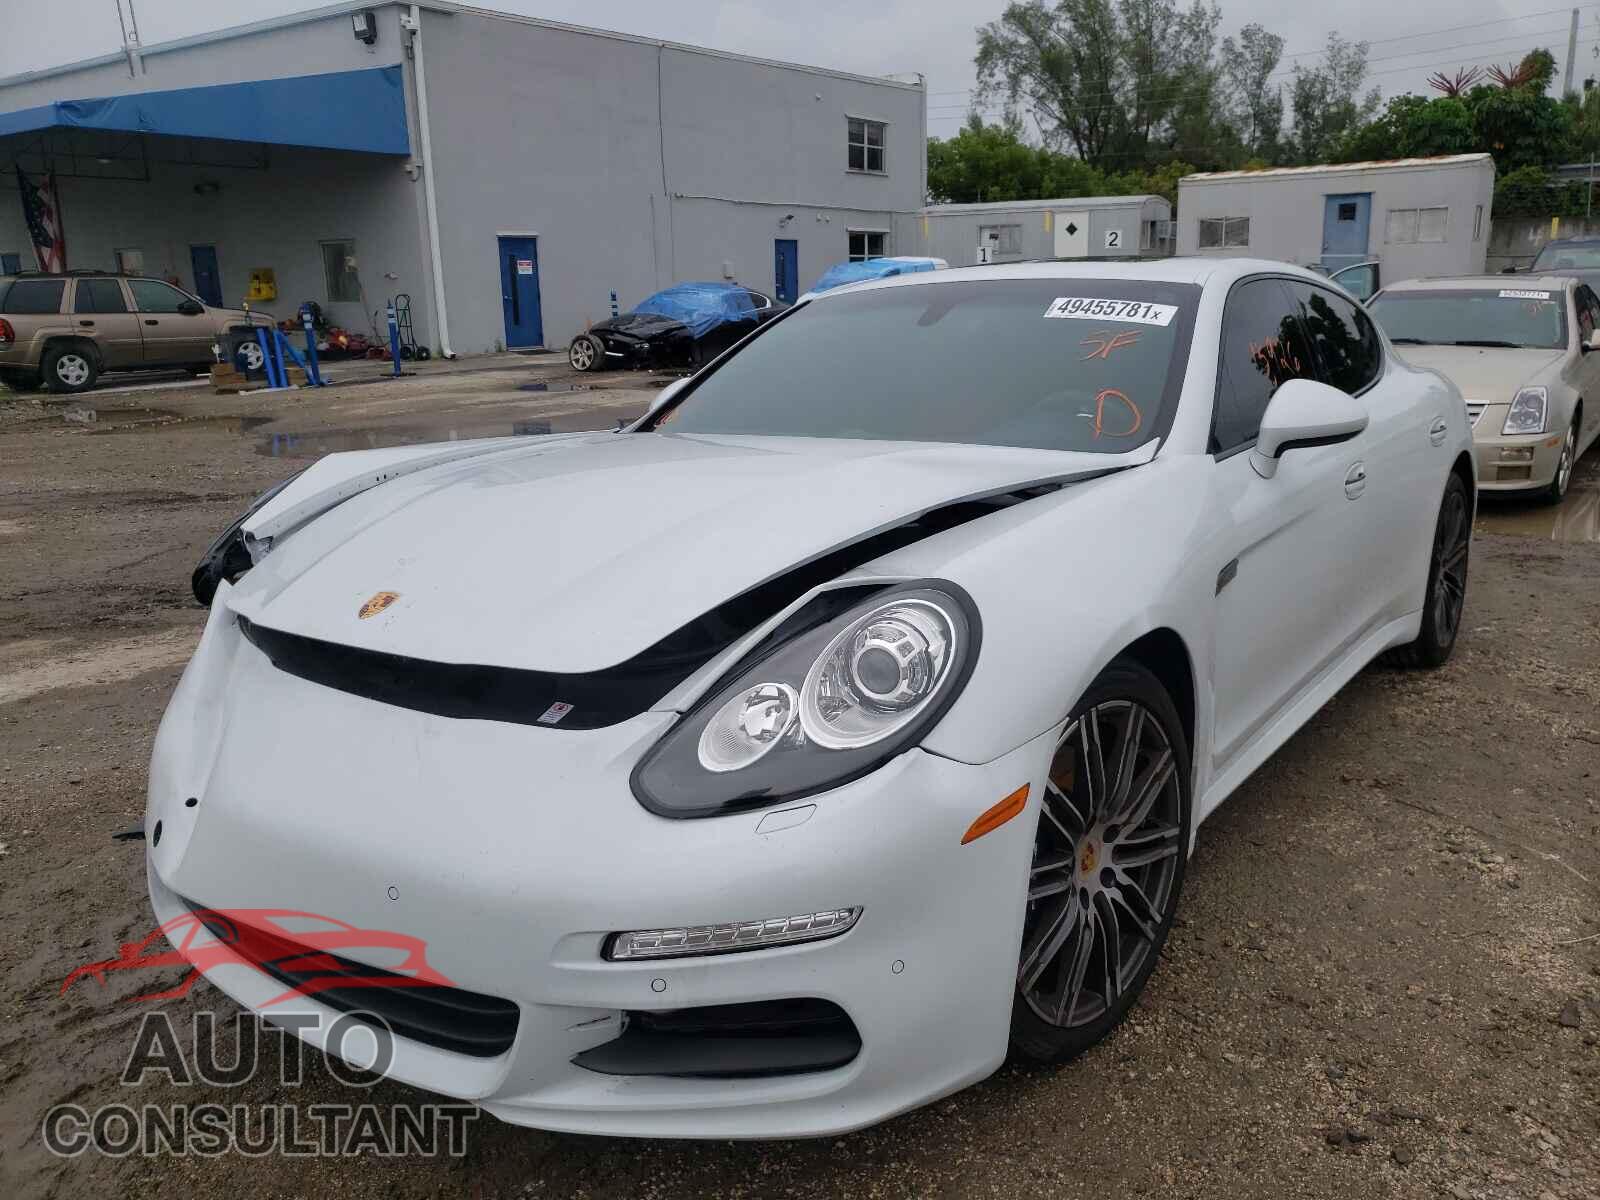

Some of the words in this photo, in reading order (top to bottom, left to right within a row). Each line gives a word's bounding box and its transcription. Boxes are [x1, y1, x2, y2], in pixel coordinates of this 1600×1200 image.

[1108, 231, 1119, 247] 2
[980, 247, 988, 262] 1
[1094, 388, 1142, 440] D
